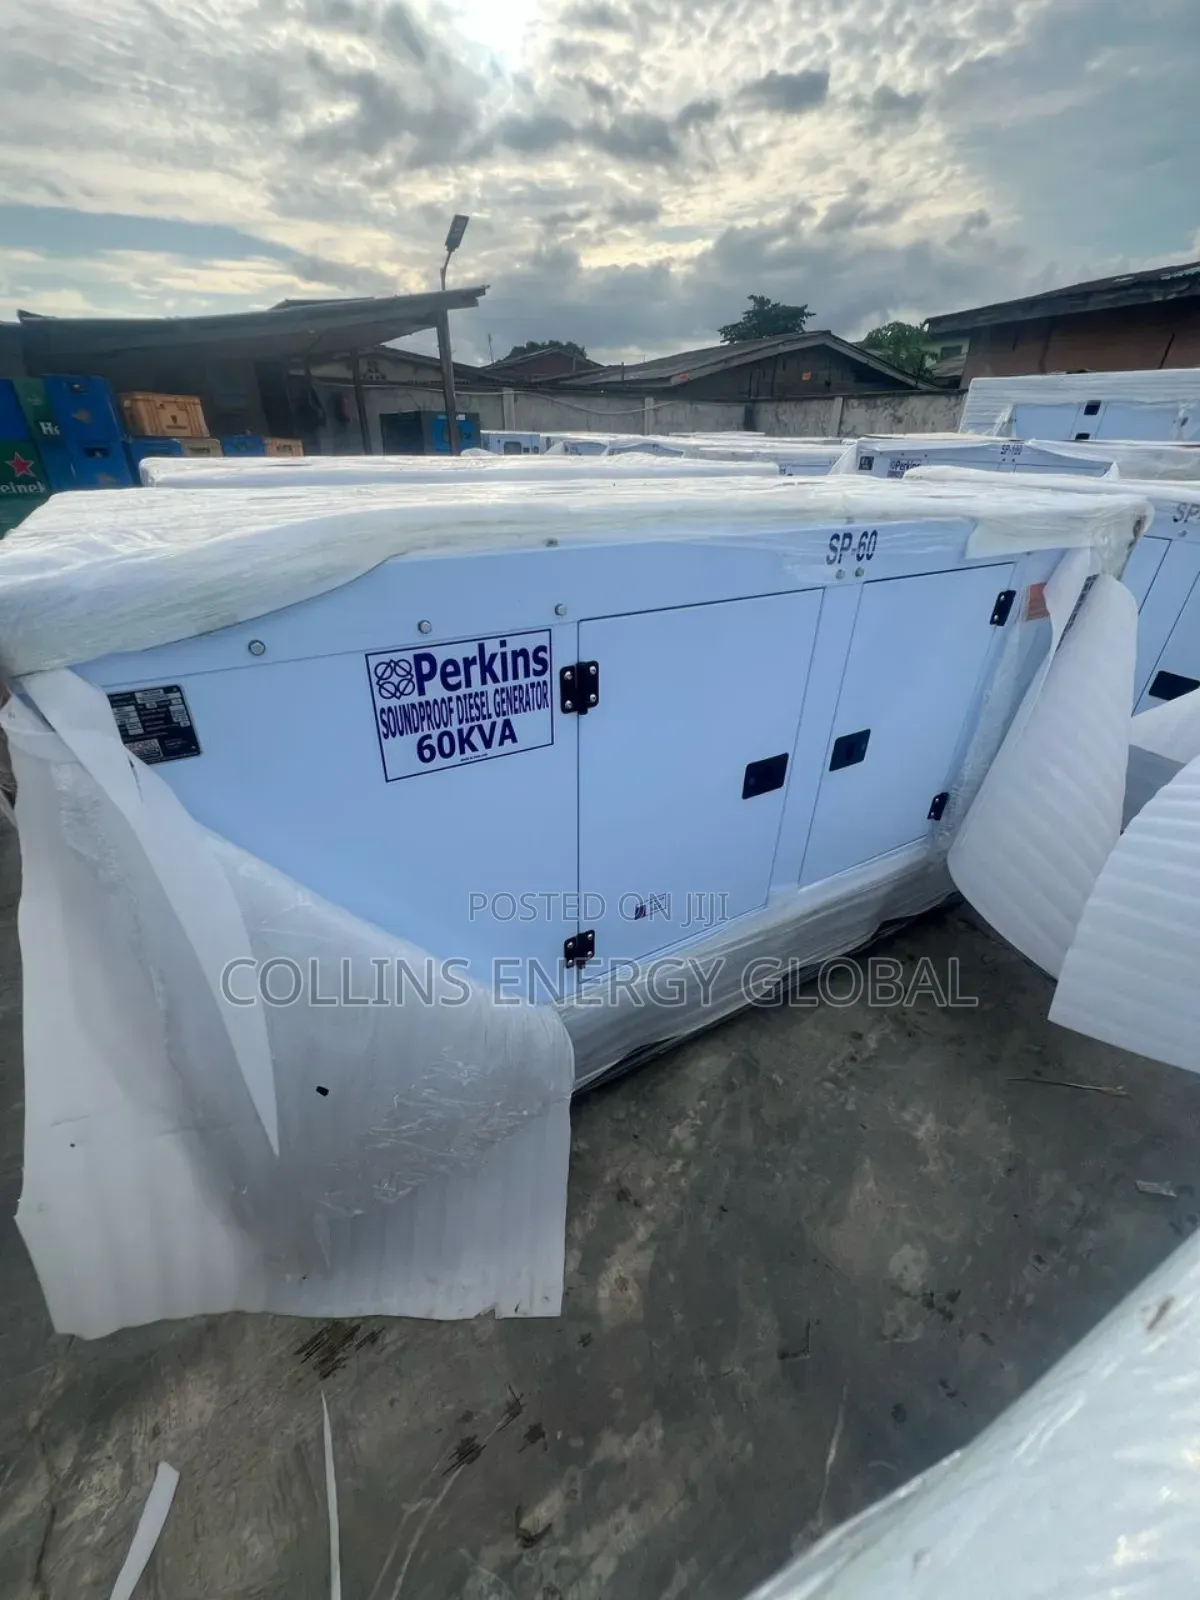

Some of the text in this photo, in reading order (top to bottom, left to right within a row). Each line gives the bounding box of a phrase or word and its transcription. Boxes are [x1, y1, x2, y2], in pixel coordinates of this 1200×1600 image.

[826, 530, 878, 565] SP-60
[413, 639, 549, 697] Perkins
[379, 679, 550, 740] SOUNDPROOF DIESEL GENERATOR
[416, 718, 518, 764] 60KVA
